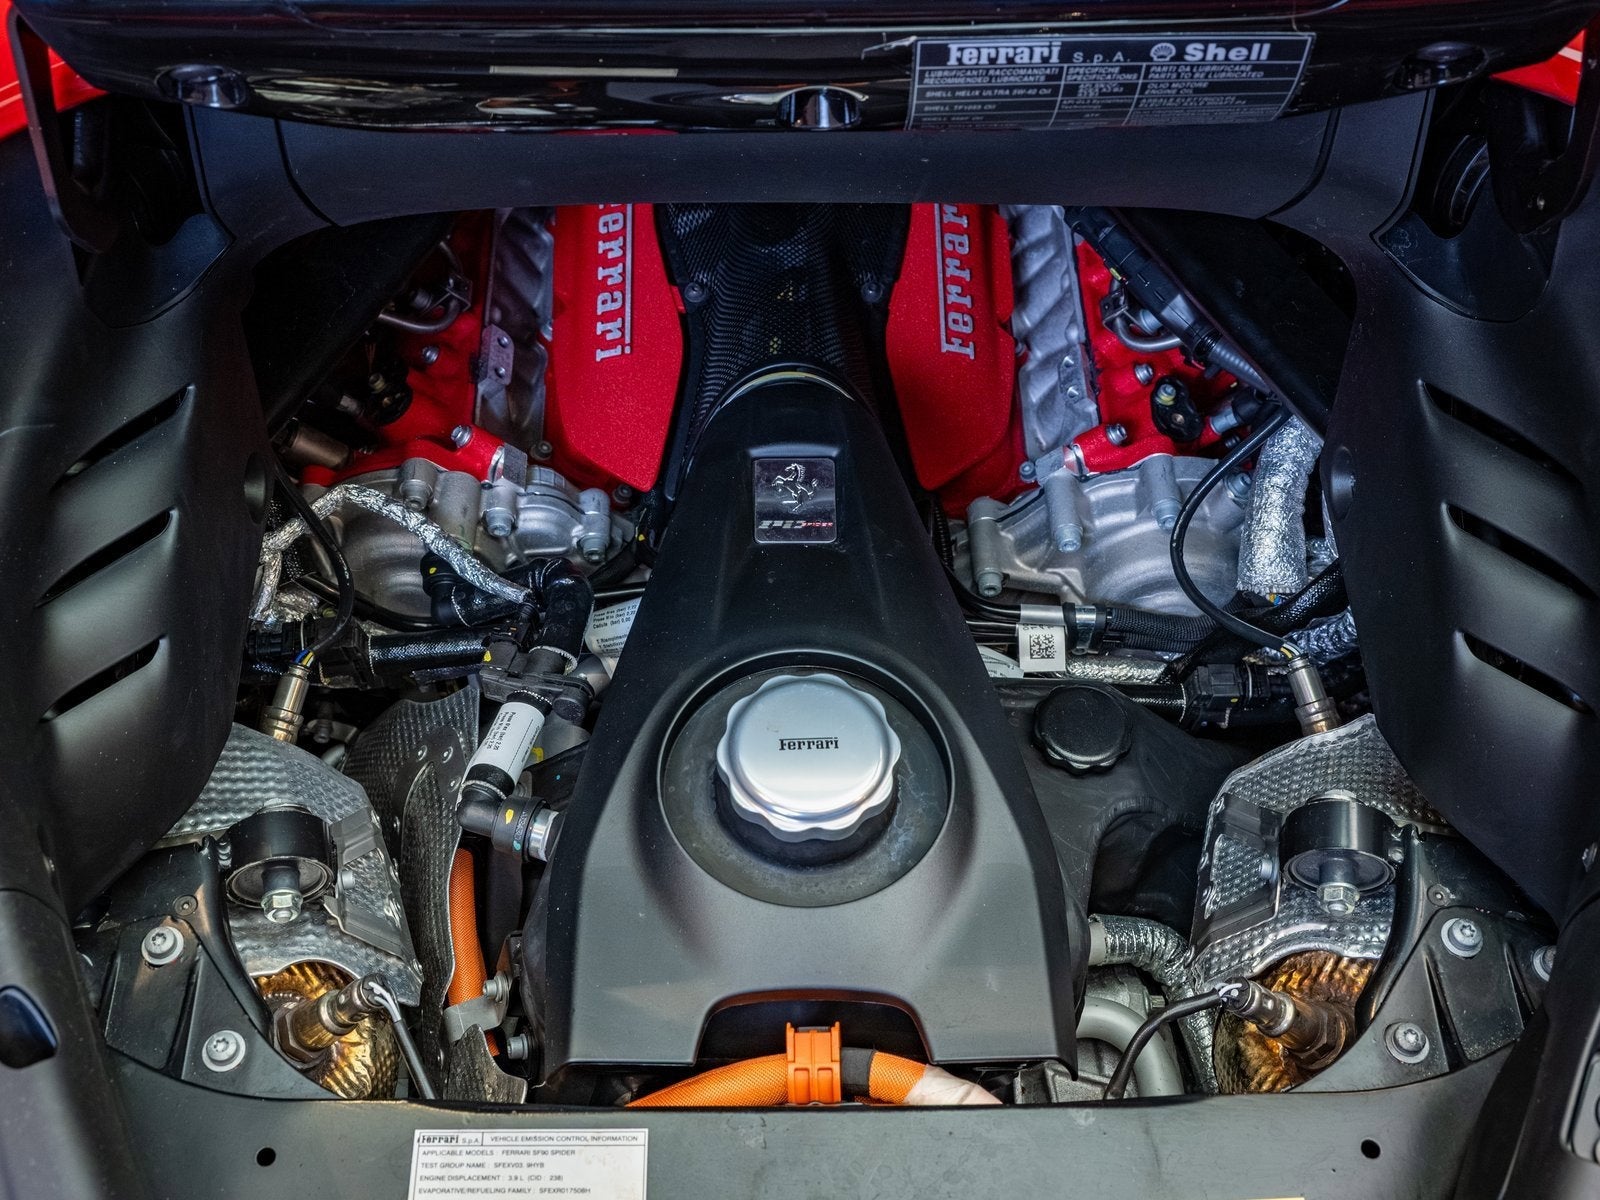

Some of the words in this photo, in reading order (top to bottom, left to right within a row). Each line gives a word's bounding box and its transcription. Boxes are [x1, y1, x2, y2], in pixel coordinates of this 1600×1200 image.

[946, 41, 1062, 66] Ferrari
[1184, 42, 1271, 62] Shell
[924, 70, 986, 78] LUBRIFICANTI
[988, 68, 1059, 76] RACCOMANDATI
[1193, 64, 1252, 72] LUBRIFICARE
[923, 77, 989, 85] RECOMMENDED
[991, 75, 1046, 83] LUBRICANTS
[1066, 73, 1138, 81] SPECIFICATIONS
[596, 204, 633, 362] errari
[934, 203, 975, 360] Ferrar
[779, 737, 839, 751] Ferrari
[421, 1134, 459, 1144] Ferrari
